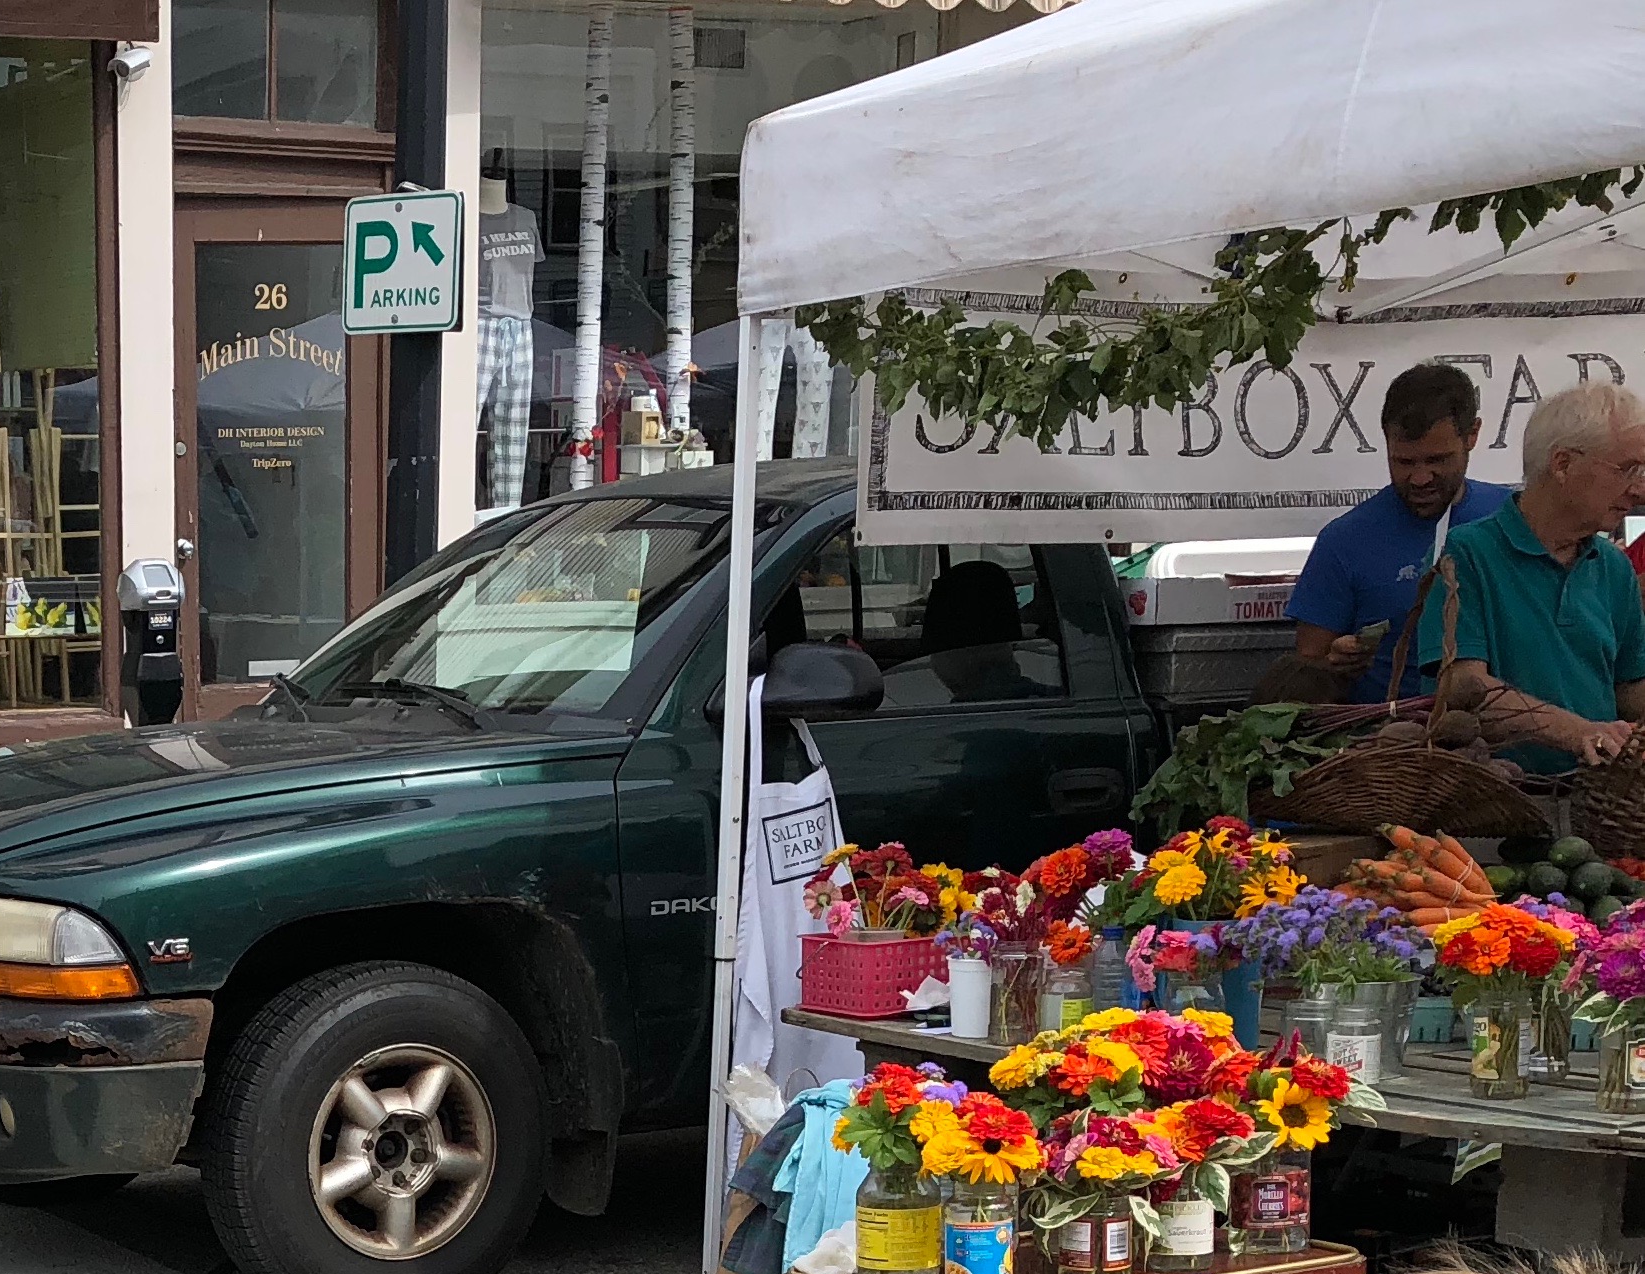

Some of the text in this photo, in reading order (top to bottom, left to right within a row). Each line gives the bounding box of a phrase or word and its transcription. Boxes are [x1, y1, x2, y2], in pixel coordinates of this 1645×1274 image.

[255, 283, 288, 310] 26
[200, 327, 344, 381] Main Street
[218, 426, 325, 438] DH INTERIOR DESIGN
[147, 937, 190, 955] V6
